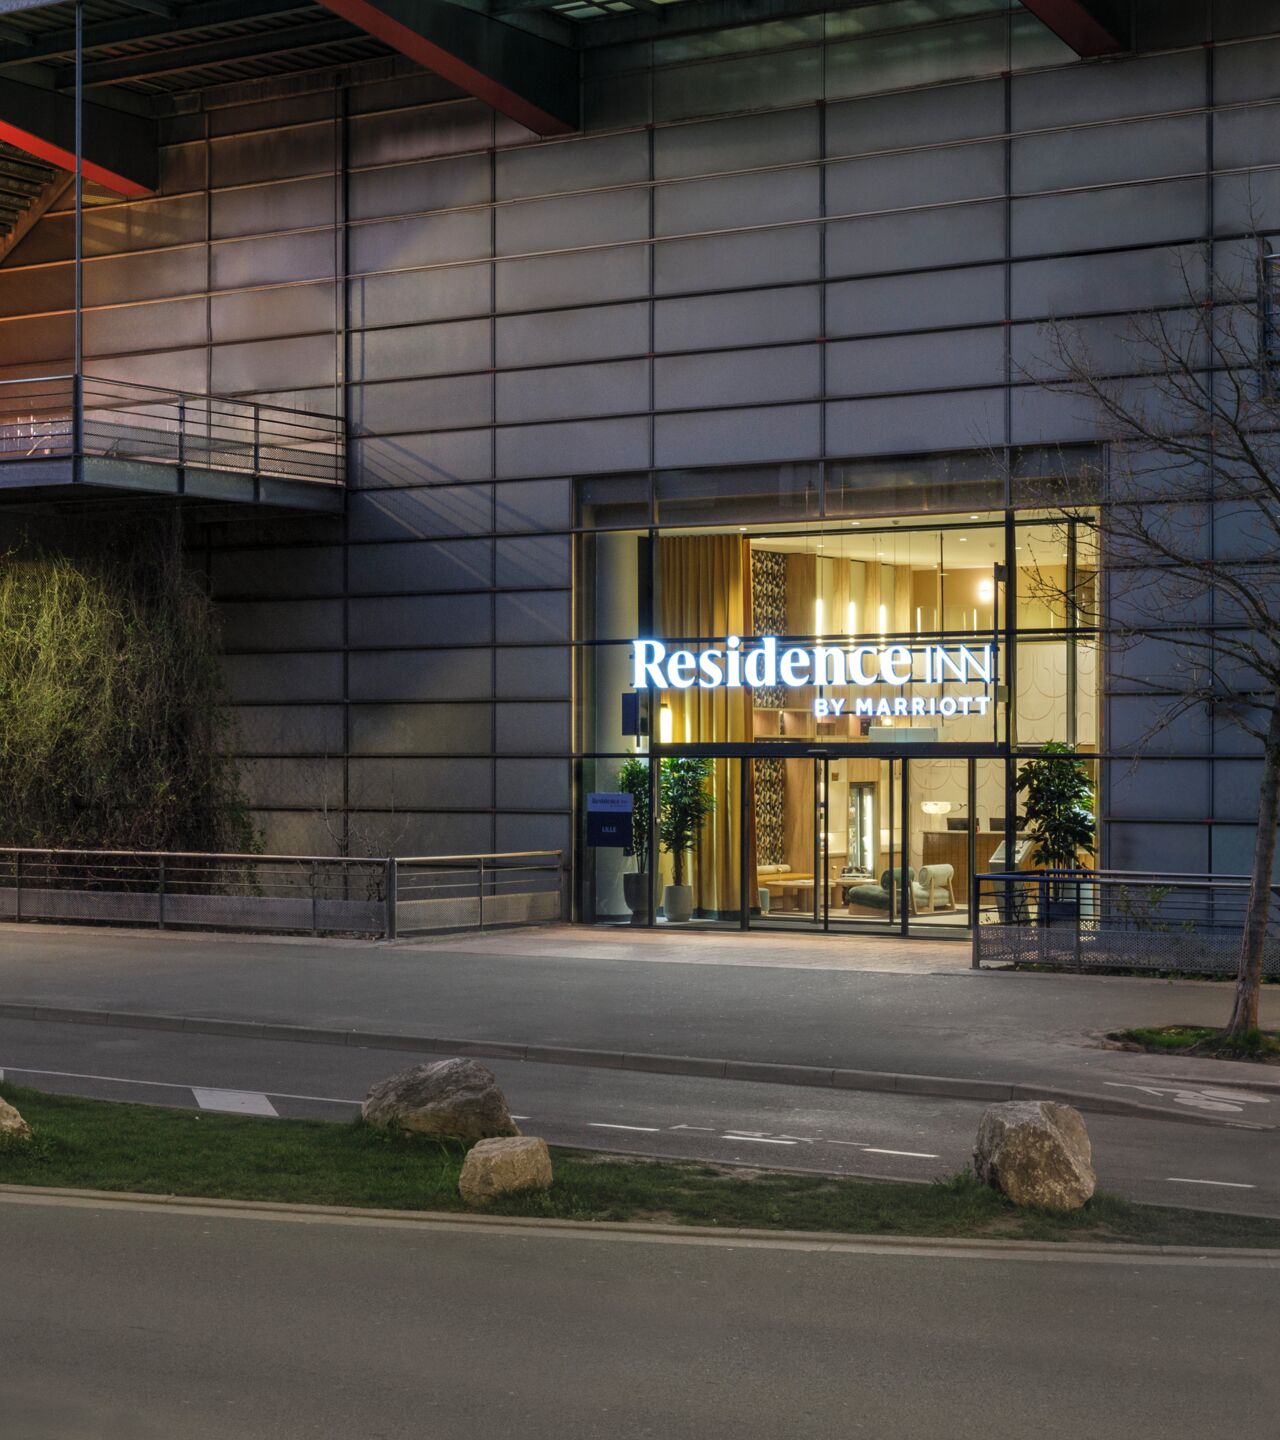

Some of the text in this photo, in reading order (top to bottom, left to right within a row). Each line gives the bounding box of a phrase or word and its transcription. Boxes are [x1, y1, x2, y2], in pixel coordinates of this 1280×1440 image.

[631, 635, 992, 690] Residence INN
[814, 696, 991, 717] BY MARRIOTT
